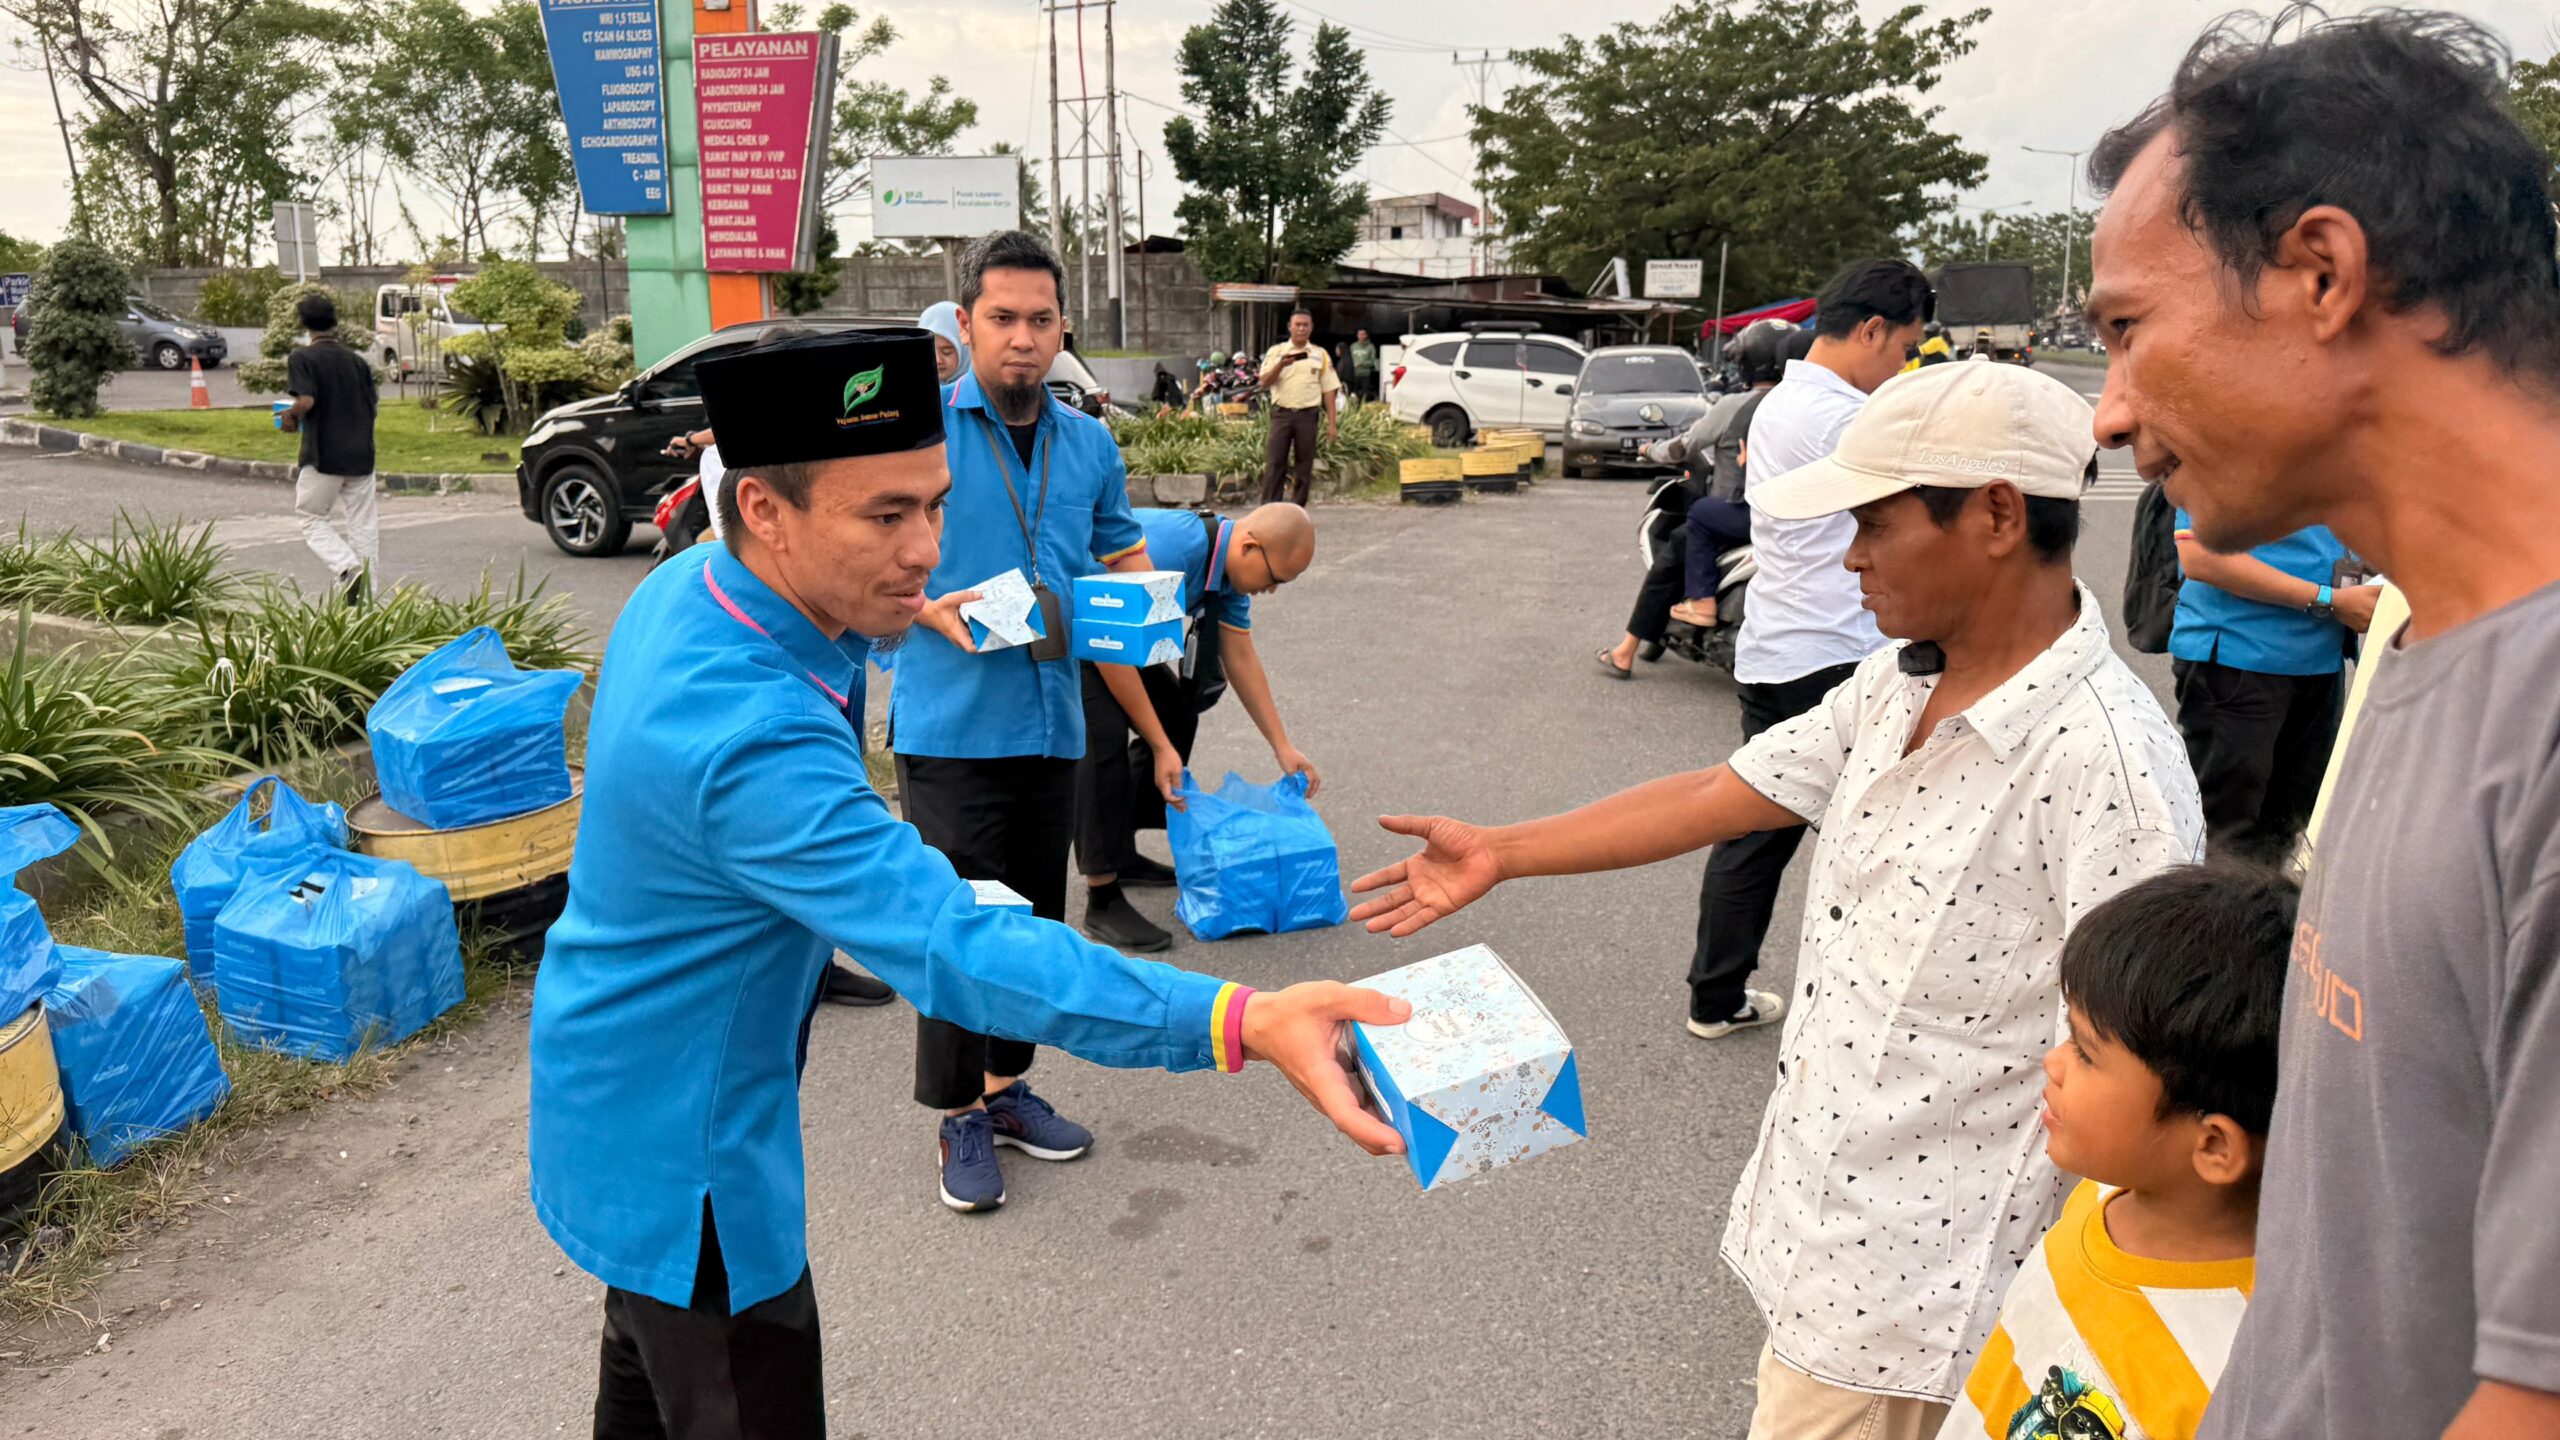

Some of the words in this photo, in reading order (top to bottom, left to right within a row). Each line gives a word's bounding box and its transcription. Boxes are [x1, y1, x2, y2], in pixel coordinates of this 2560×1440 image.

[599, 12, 614, 25] MRI
[626, 11, 652, 24] TESLA
[582, 31, 593, 43] CT
[594, 30, 615, 42] SCAN
[615, 30, 625, 42] 64
[626, 28, 653, 41] SLICES
[594, 47, 653, 61] MAMMOGRAPHY
[699, 40, 808, 58] PELAYANAN
[625, 65, 640, 78] USG
[641, 64, 648, 77] 4
[700, 68, 741, 80] RADIOLOGY
[742, 67, 753, 79] 24
[753, 66, 770, 78] JAM
[601, 82, 655, 96] FLUOROSCOPY
[701, 84, 758, 97] LABORATORIUM
[758, 84, 769, 95] 24
[769, 83, 785, 95] JAM
[603, 100, 655, 113] LAPAROSCOPY
[702, 101, 762, 114] PHYSIOTERAPHY
[603, 117, 656, 130] ARTHROSCOPY
[581, 134, 658, 148] ECHOCARDIOGRAPHY
[704, 135, 735, 147] MEDICAL
[758, 134, 770, 146] UP
[705, 152, 729, 163] RAWAT
[730, 151, 748, 163] INAP
[749, 151, 763, 162] VIP
[633, 168, 640, 182] C
[644, 168, 662, 181] ARM
[705, 168, 730, 180] RAWAT
[731, 168, 750, 179] INAP
[750, 167, 776, 179] KELAS
[645, 186, 662, 200] EEG
[706, 184, 731, 195] RAWAT
[732, 184, 751, 195] INAP
[751, 184, 773, 196] ANAK
[707, 200, 749, 211] KEBIDANAN
[709, 231, 758, 243] HEMODIALISA
[709, 249, 743, 260] LAYANAN
[765, 248, 786, 259] ANAK
